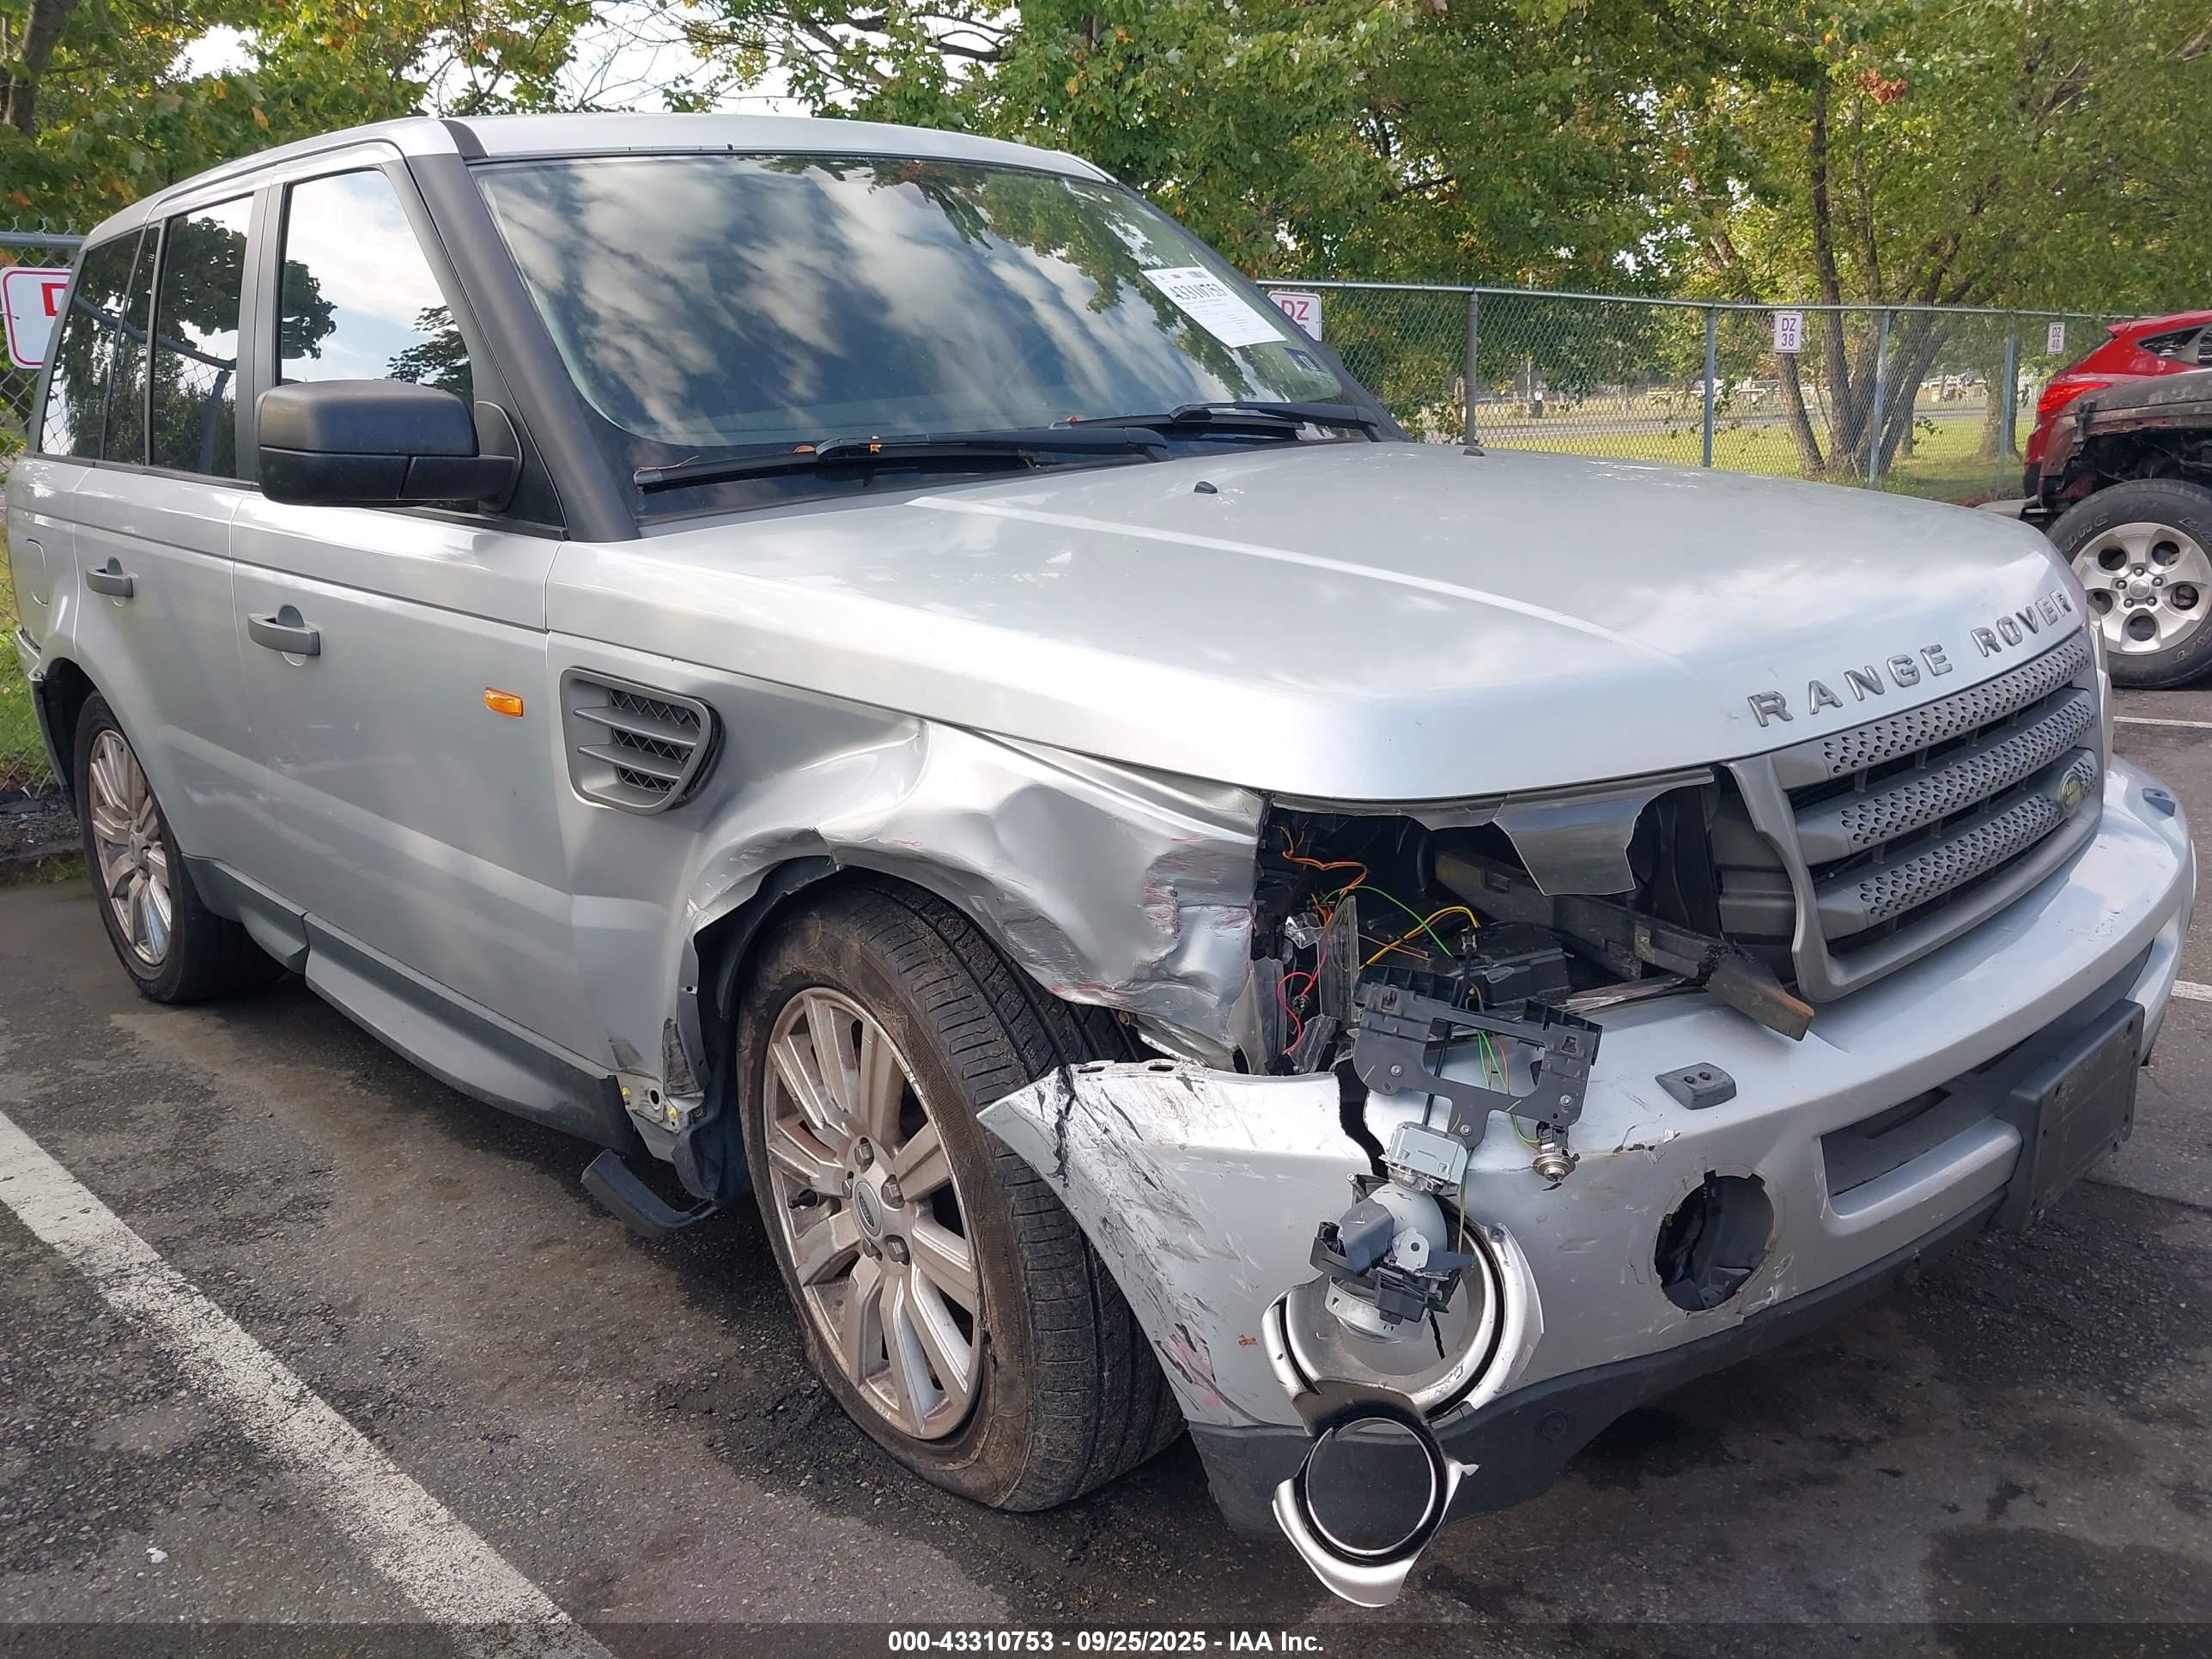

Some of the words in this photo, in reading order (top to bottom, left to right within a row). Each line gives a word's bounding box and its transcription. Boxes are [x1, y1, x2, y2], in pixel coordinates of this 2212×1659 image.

[1281, 300, 1310, 321] DZ
[1782, 318, 1796, 331] DZ
[2052, 327, 2062, 338] DZ
[1781, 333, 1795, 347] 38
[2051, 338, 2060, 349] 40
[1747, 644, 1954, 727] RANGE
[1970, 589, 2074, 658] ROVER
